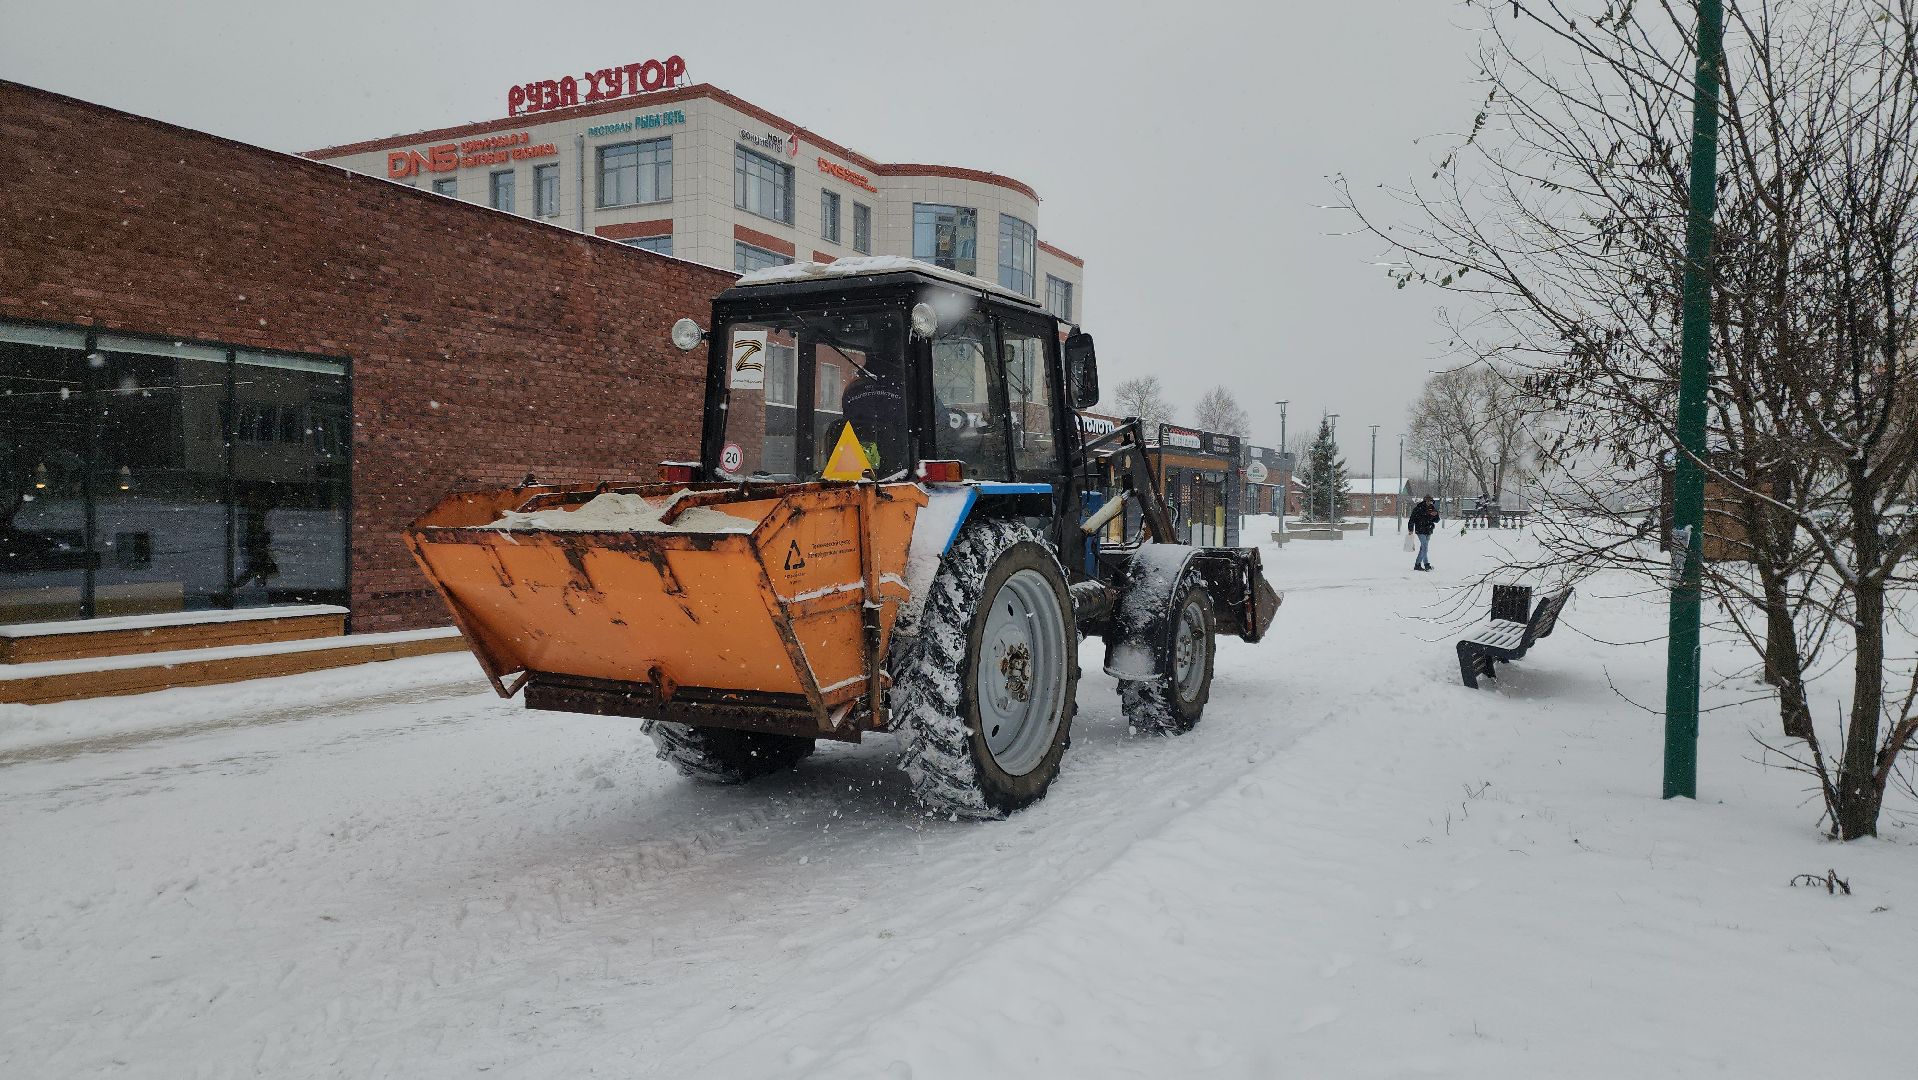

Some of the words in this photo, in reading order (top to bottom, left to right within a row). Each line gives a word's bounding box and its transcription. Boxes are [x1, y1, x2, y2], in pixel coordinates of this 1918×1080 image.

[508, 75, 578, 117] РУЗА
[584, 54, 686, 103] ХУТОР
[635, 113, 660, 129] РЫБА
[387, 143, 459, 179] DNS
[818, 156, 848, 181] DNS
[724, 451, 738, 465] 20
